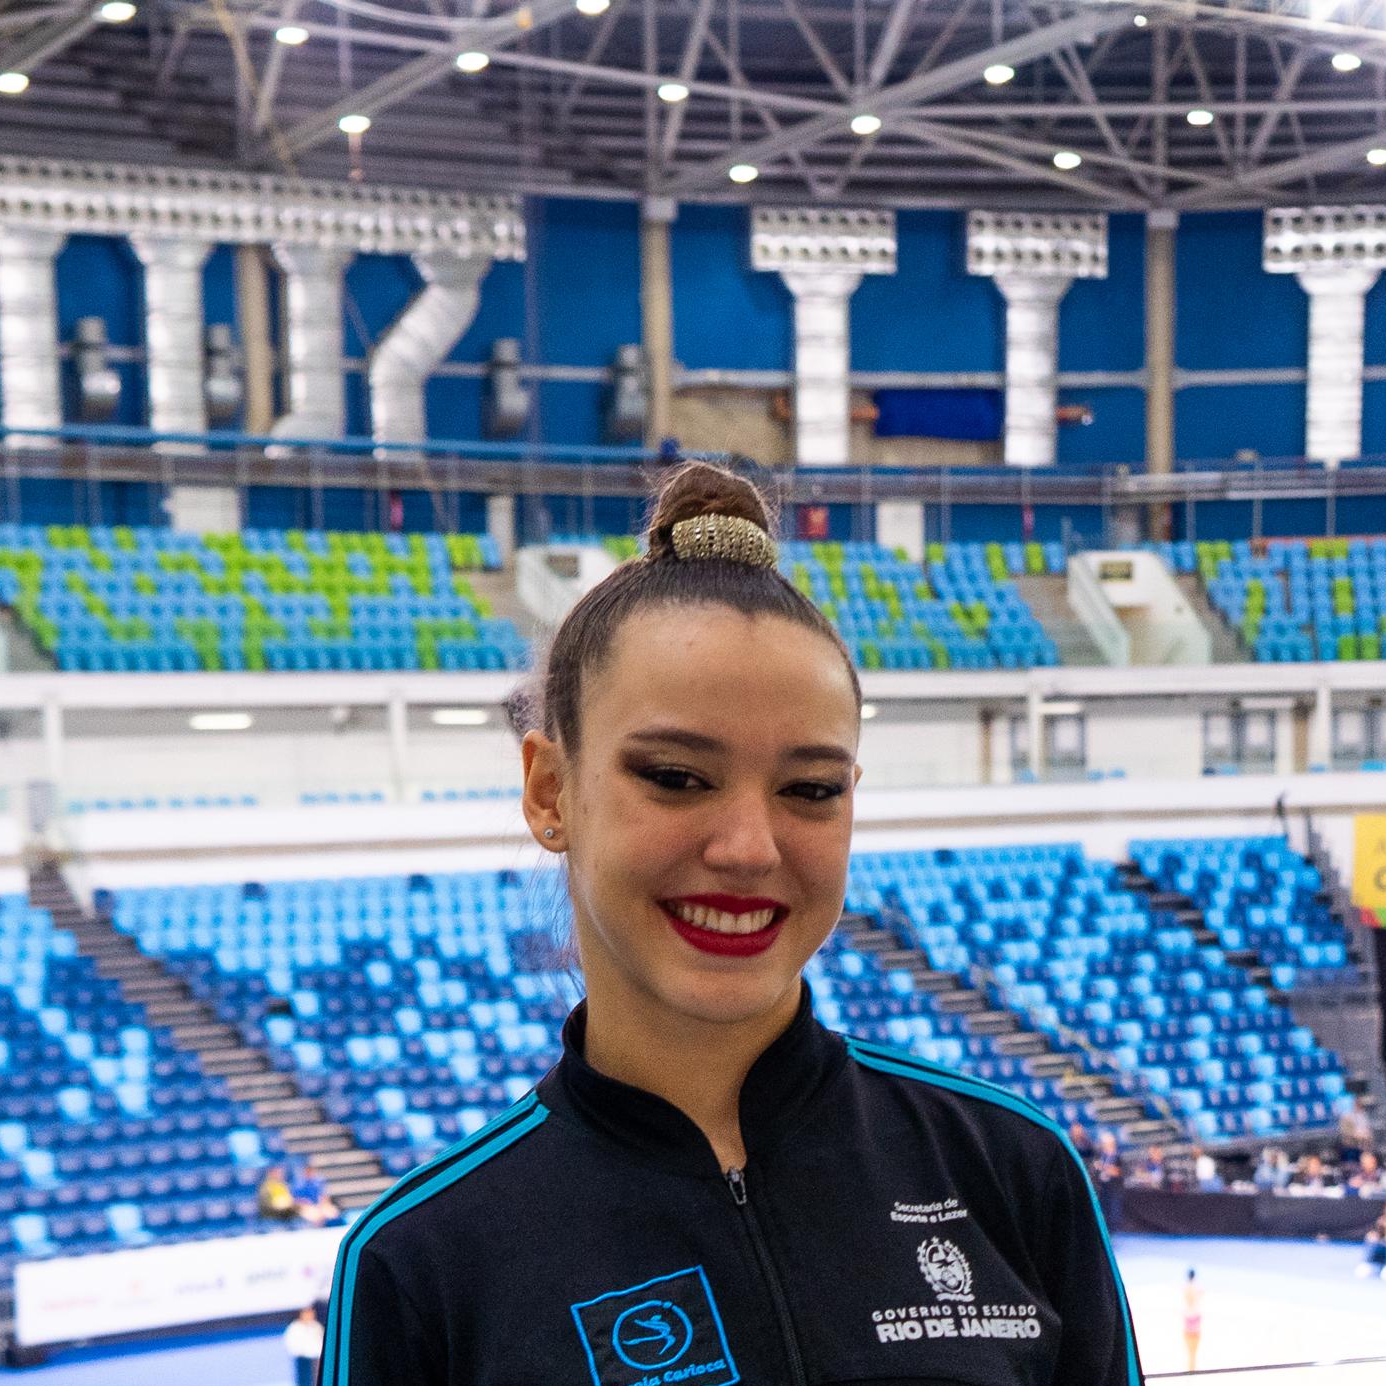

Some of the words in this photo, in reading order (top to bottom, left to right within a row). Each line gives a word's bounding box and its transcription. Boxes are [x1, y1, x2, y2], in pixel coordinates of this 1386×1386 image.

[944, 1198, 959, 1209] de
[938, 1209, 968, 1222] Lazer
[871, 1304, 953, 1322] GOVERNO
[957, 1304, 977, 1316] DO
[982, 1304, 1037, 1317] ESTADO
[875, 1319, 924, 1344] RIO
[924, 1318, 959, 1339] DE
[663, 1358, 727, 1383] Carioca
